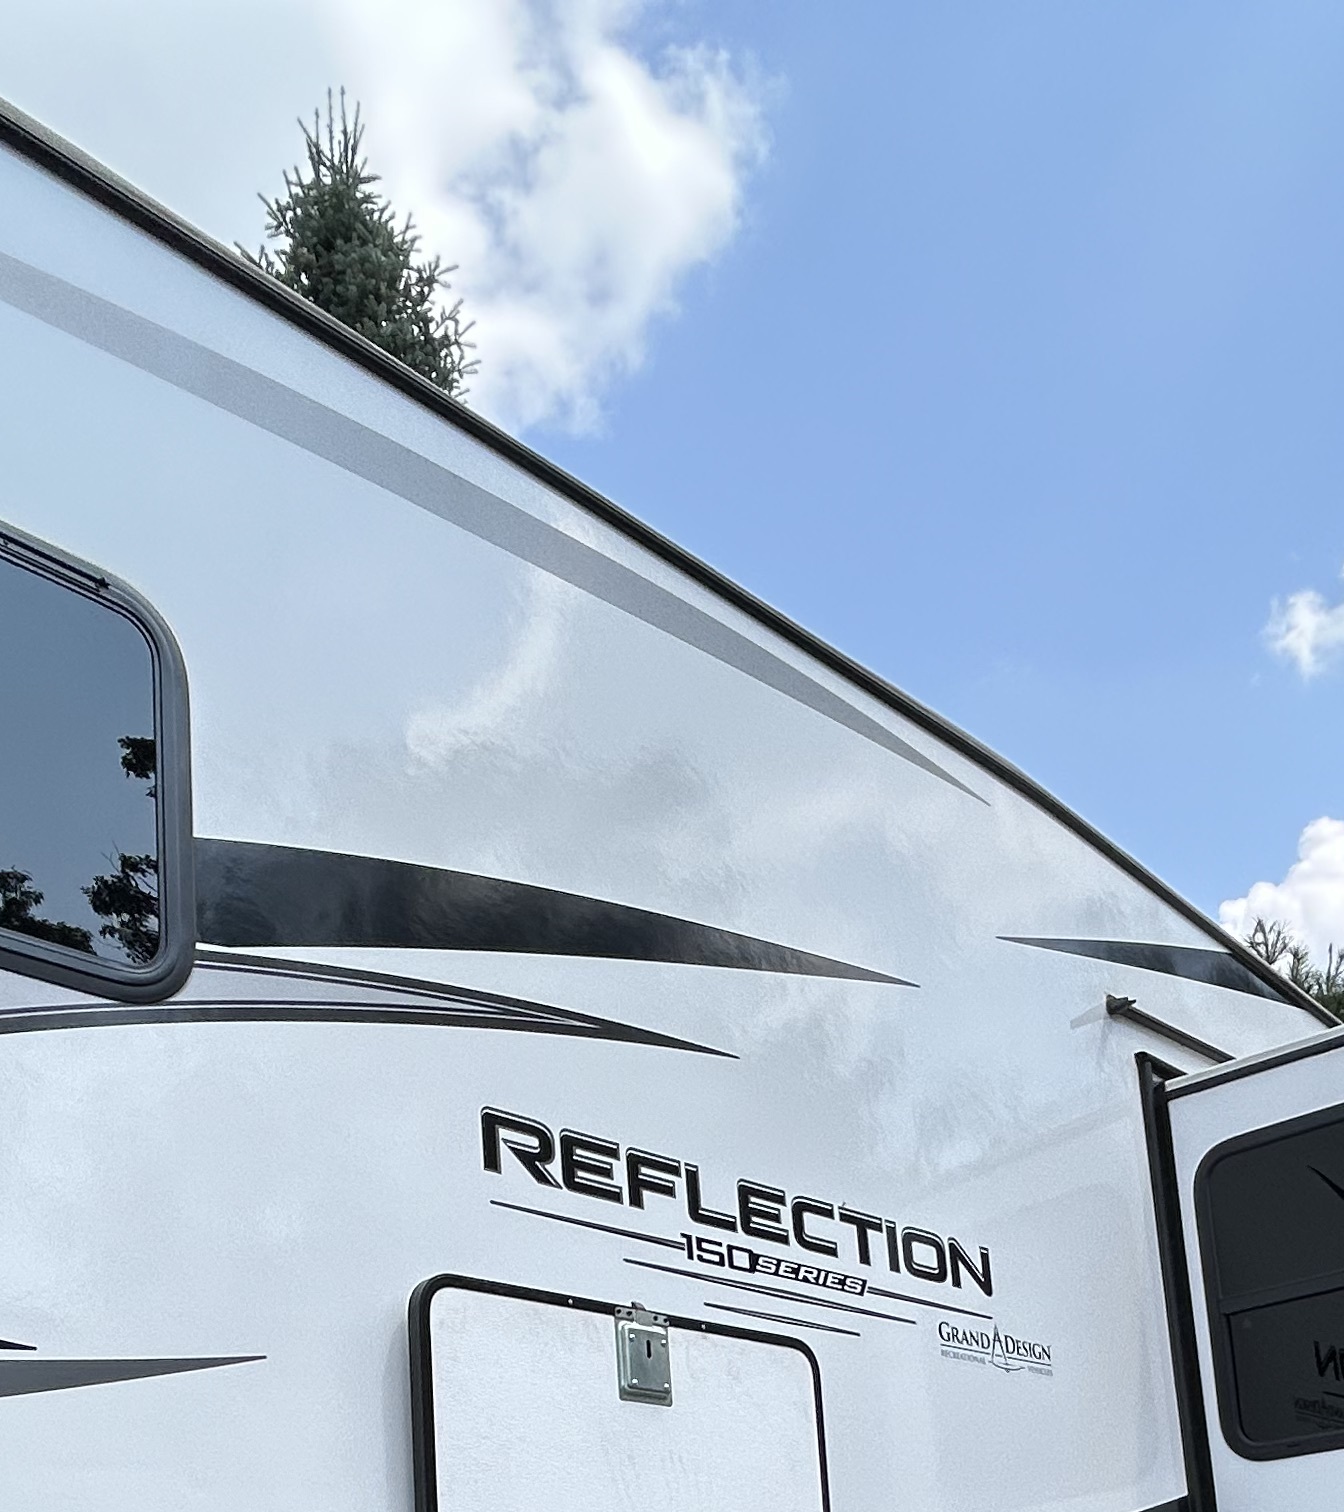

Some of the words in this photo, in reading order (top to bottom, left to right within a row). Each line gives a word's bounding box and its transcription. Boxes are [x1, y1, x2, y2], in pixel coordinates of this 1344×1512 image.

[480, 1106, 994, 1298] REFLECTION
[680, 1232, 756, 1275] 150
[755, 1254, 864, 1295] SERIES
[938, 1321, 991, 1350] GRAND
[1003, 1334, 1052, 1362] DESIGN
